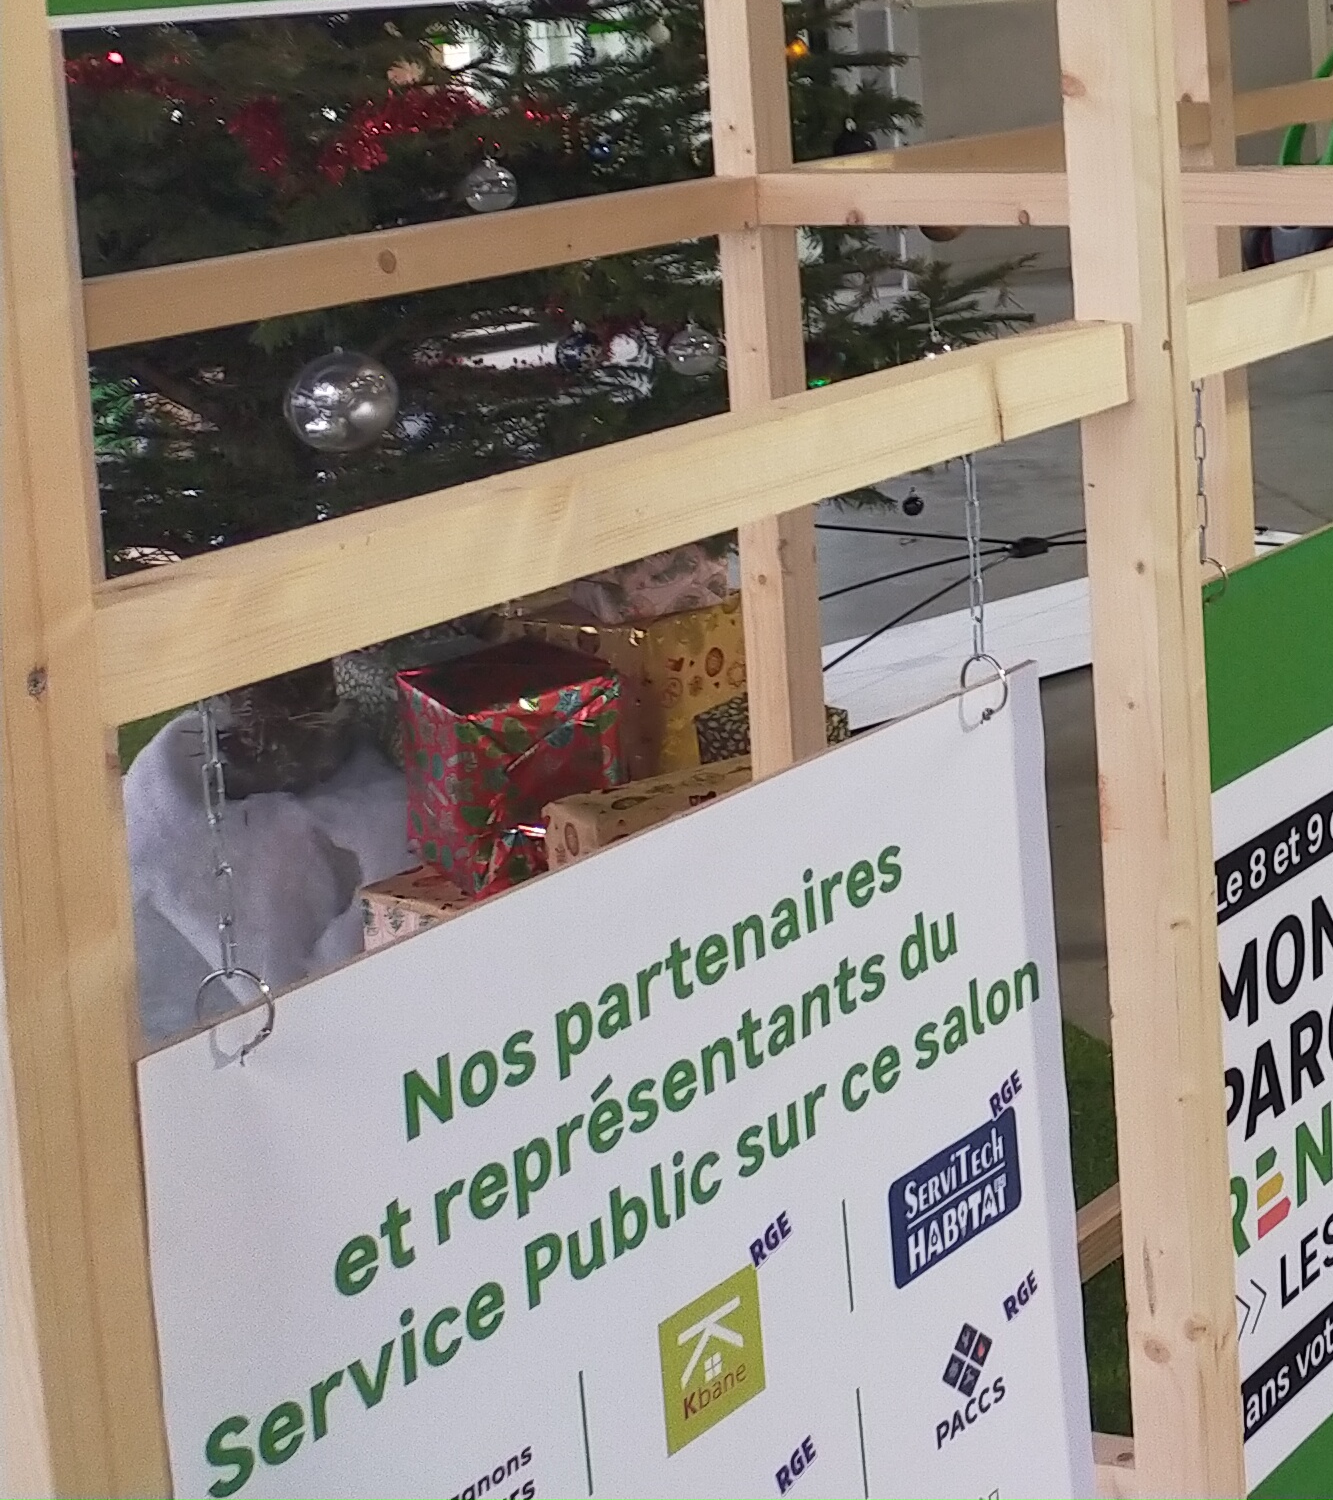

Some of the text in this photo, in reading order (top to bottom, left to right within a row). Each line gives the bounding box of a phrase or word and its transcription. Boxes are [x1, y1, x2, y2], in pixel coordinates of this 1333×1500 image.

[1249, 846, 1267, 890] 8
[1273, 825, 1301, 875] et
[1307, 813, 1324, 853] 9
[401, 842, 903, 1140] Nos partenaires
[335, 909, 958, 1297] et représentants du
[989, 1069, 1023, 1118] RGE
[204, 957, 1041, 1499] Service Public sur ce salon
[749, 1210, 792, 1268] RGE
[1003, 1270, 1038, 1321] RGE
[683, 1361, 748, 1421] Kbane
[936, 1376, 1006, 1450] PACCS
[1246, 1364, 1290, 1427] ans
[775, 1435, 817, 1496] RGE
